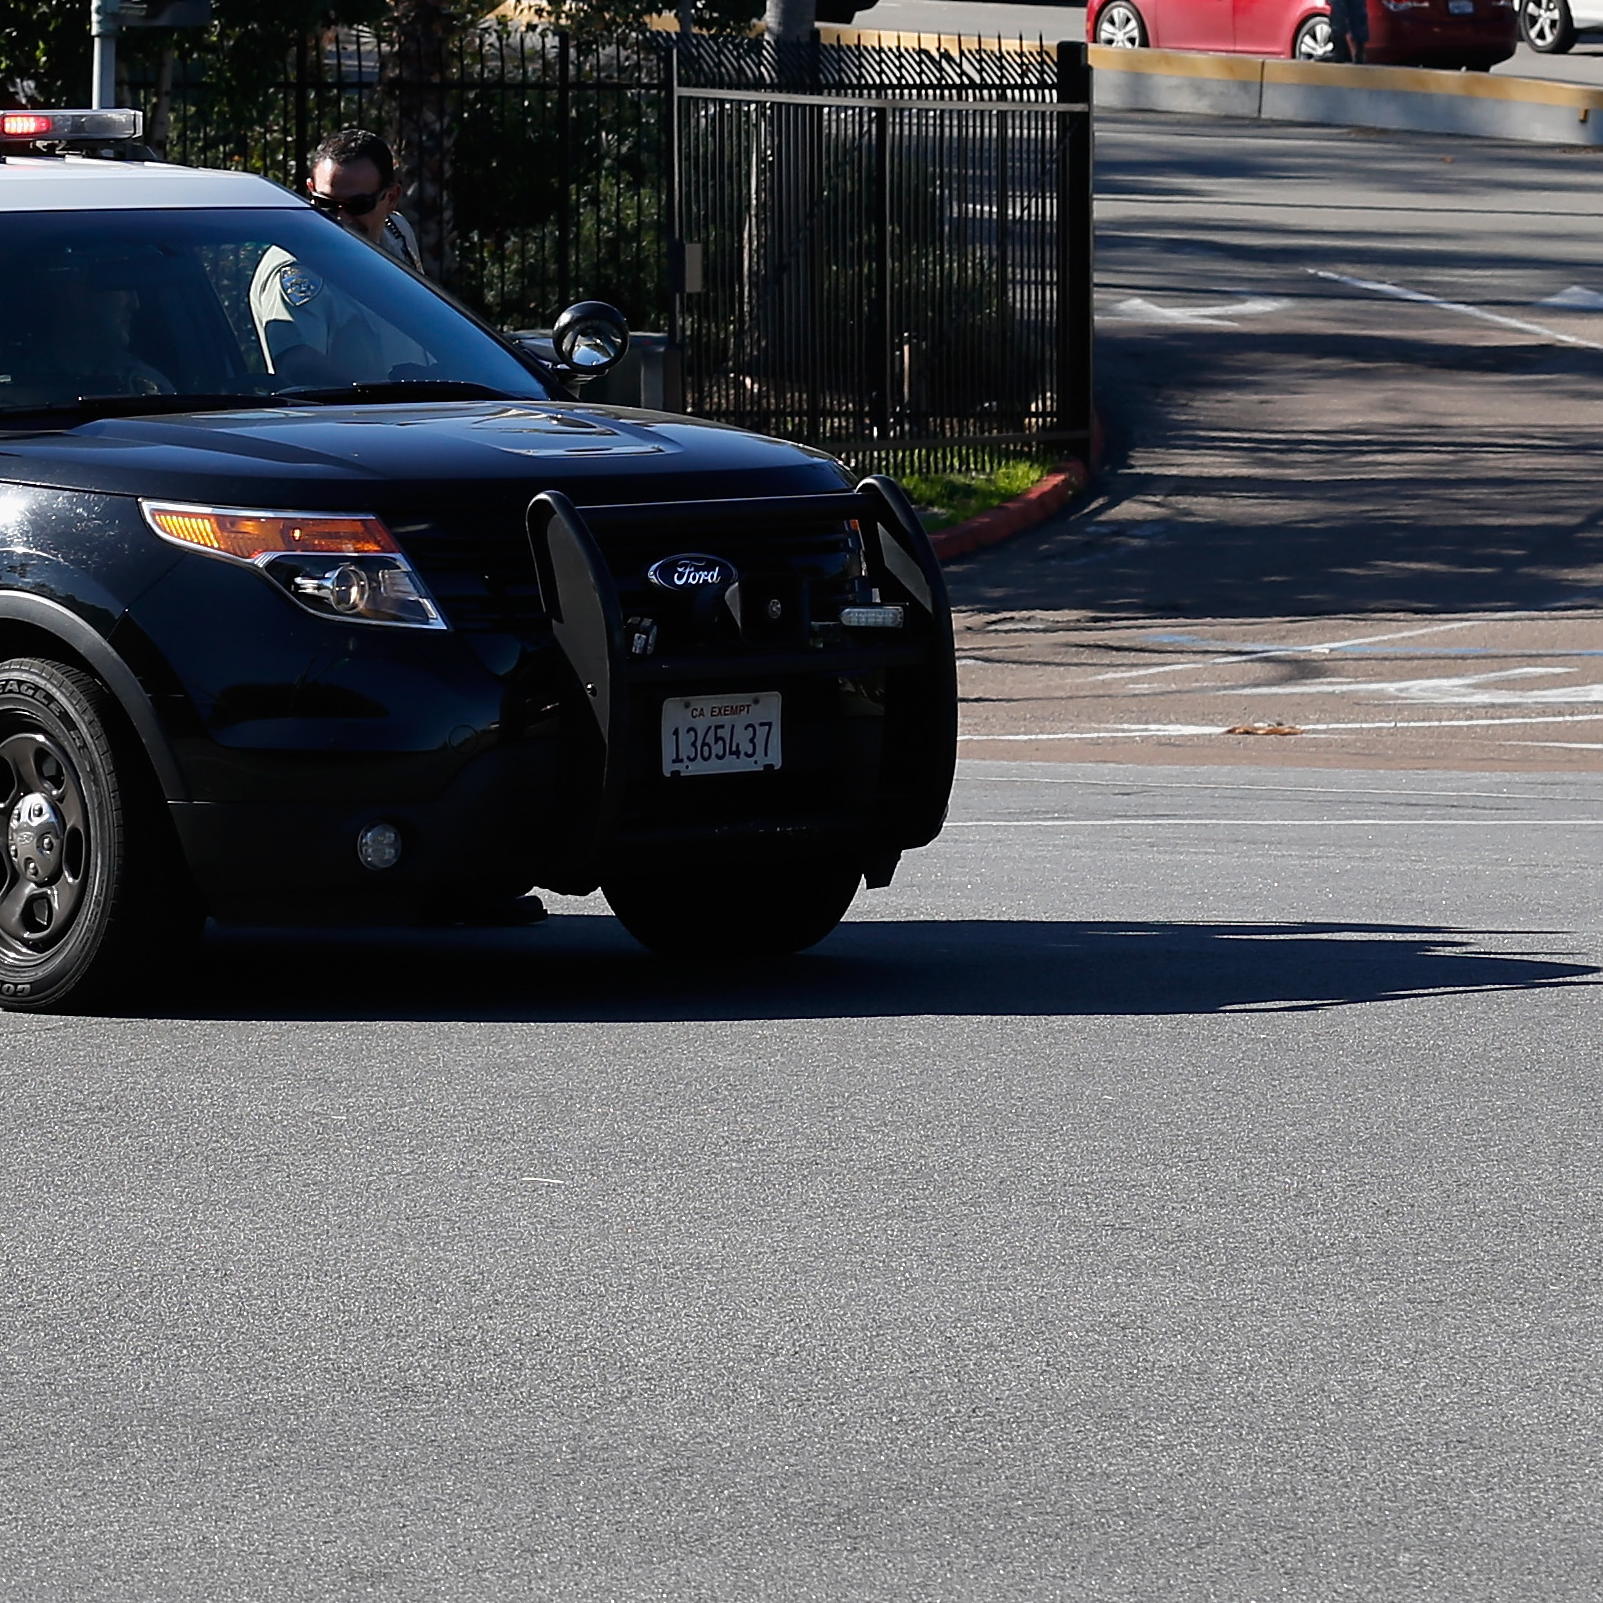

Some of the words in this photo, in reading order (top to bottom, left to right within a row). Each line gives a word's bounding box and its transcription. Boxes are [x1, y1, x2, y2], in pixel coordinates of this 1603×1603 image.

[673, 560, 722, 585] Ford
[690, 707, 706, 719] CA
[710, 703, 752, 718] EXEMPT
[671, 720, 773, 764] 1365437
